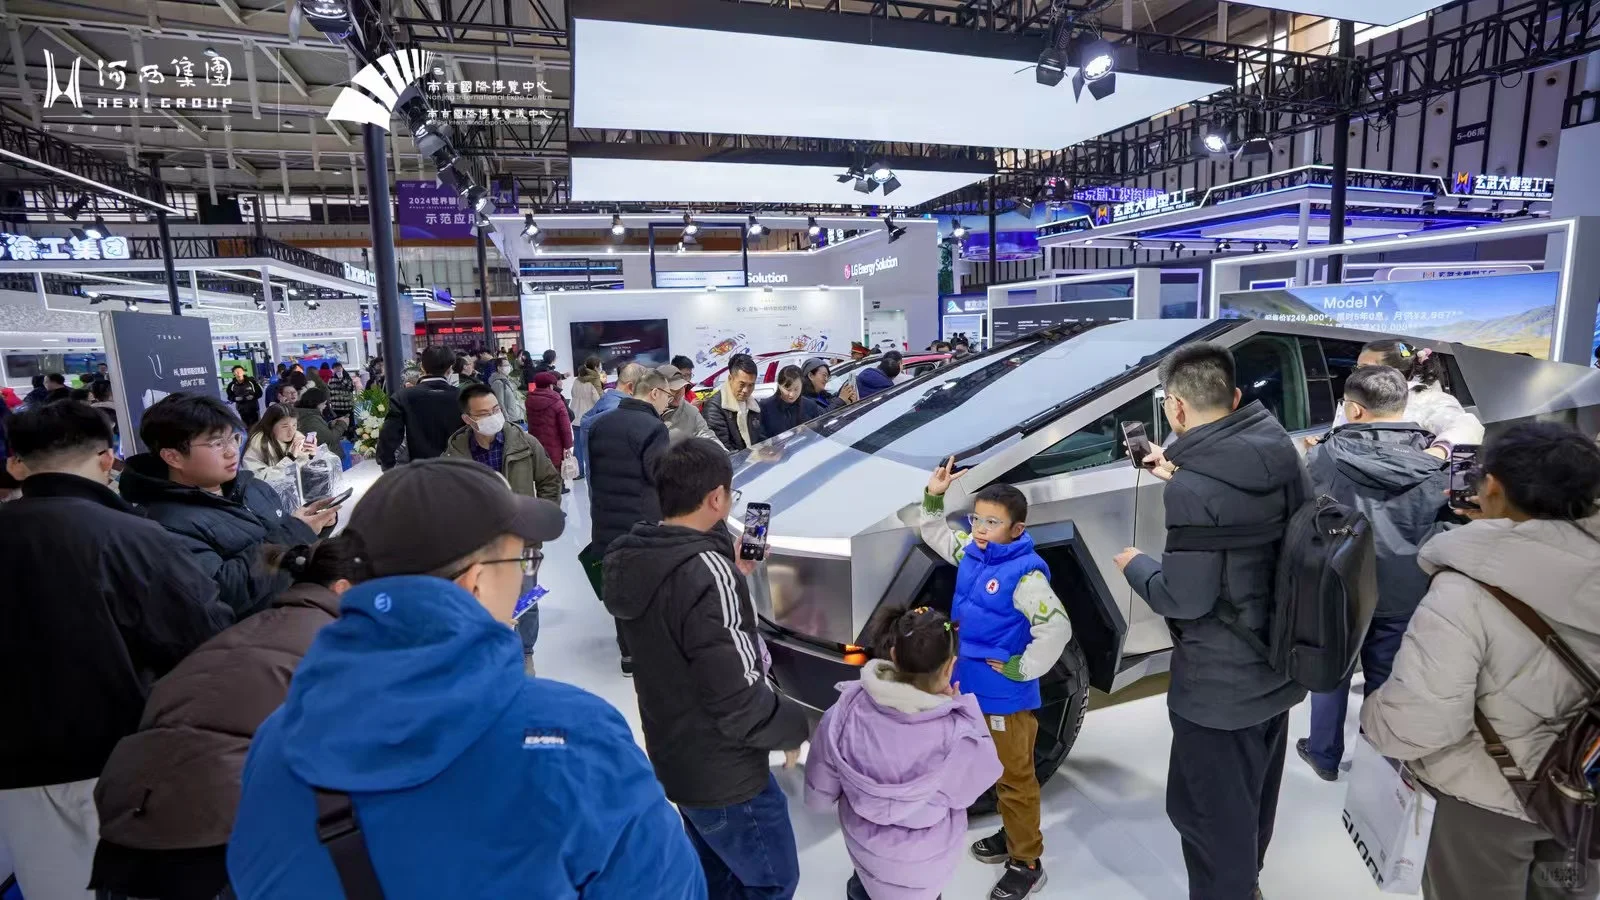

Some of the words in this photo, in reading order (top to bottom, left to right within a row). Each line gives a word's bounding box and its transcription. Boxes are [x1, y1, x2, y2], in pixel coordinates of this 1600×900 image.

[1475, 174, 1554, 192] 玄武大模型工厂
[1113, 187, 1195, 218] 玄武大模型工厂
[7, 235, 131, 260] 徐工集团
[851, 263, 858, 277] LG
[858, 262, 875, 276] Energy
[875, 255, 898, 272] Solution
[747, 272, 788, 283] Solution
[1323, 296, 1368, 309] Model
[1372, 295, 1384, 307] Y
